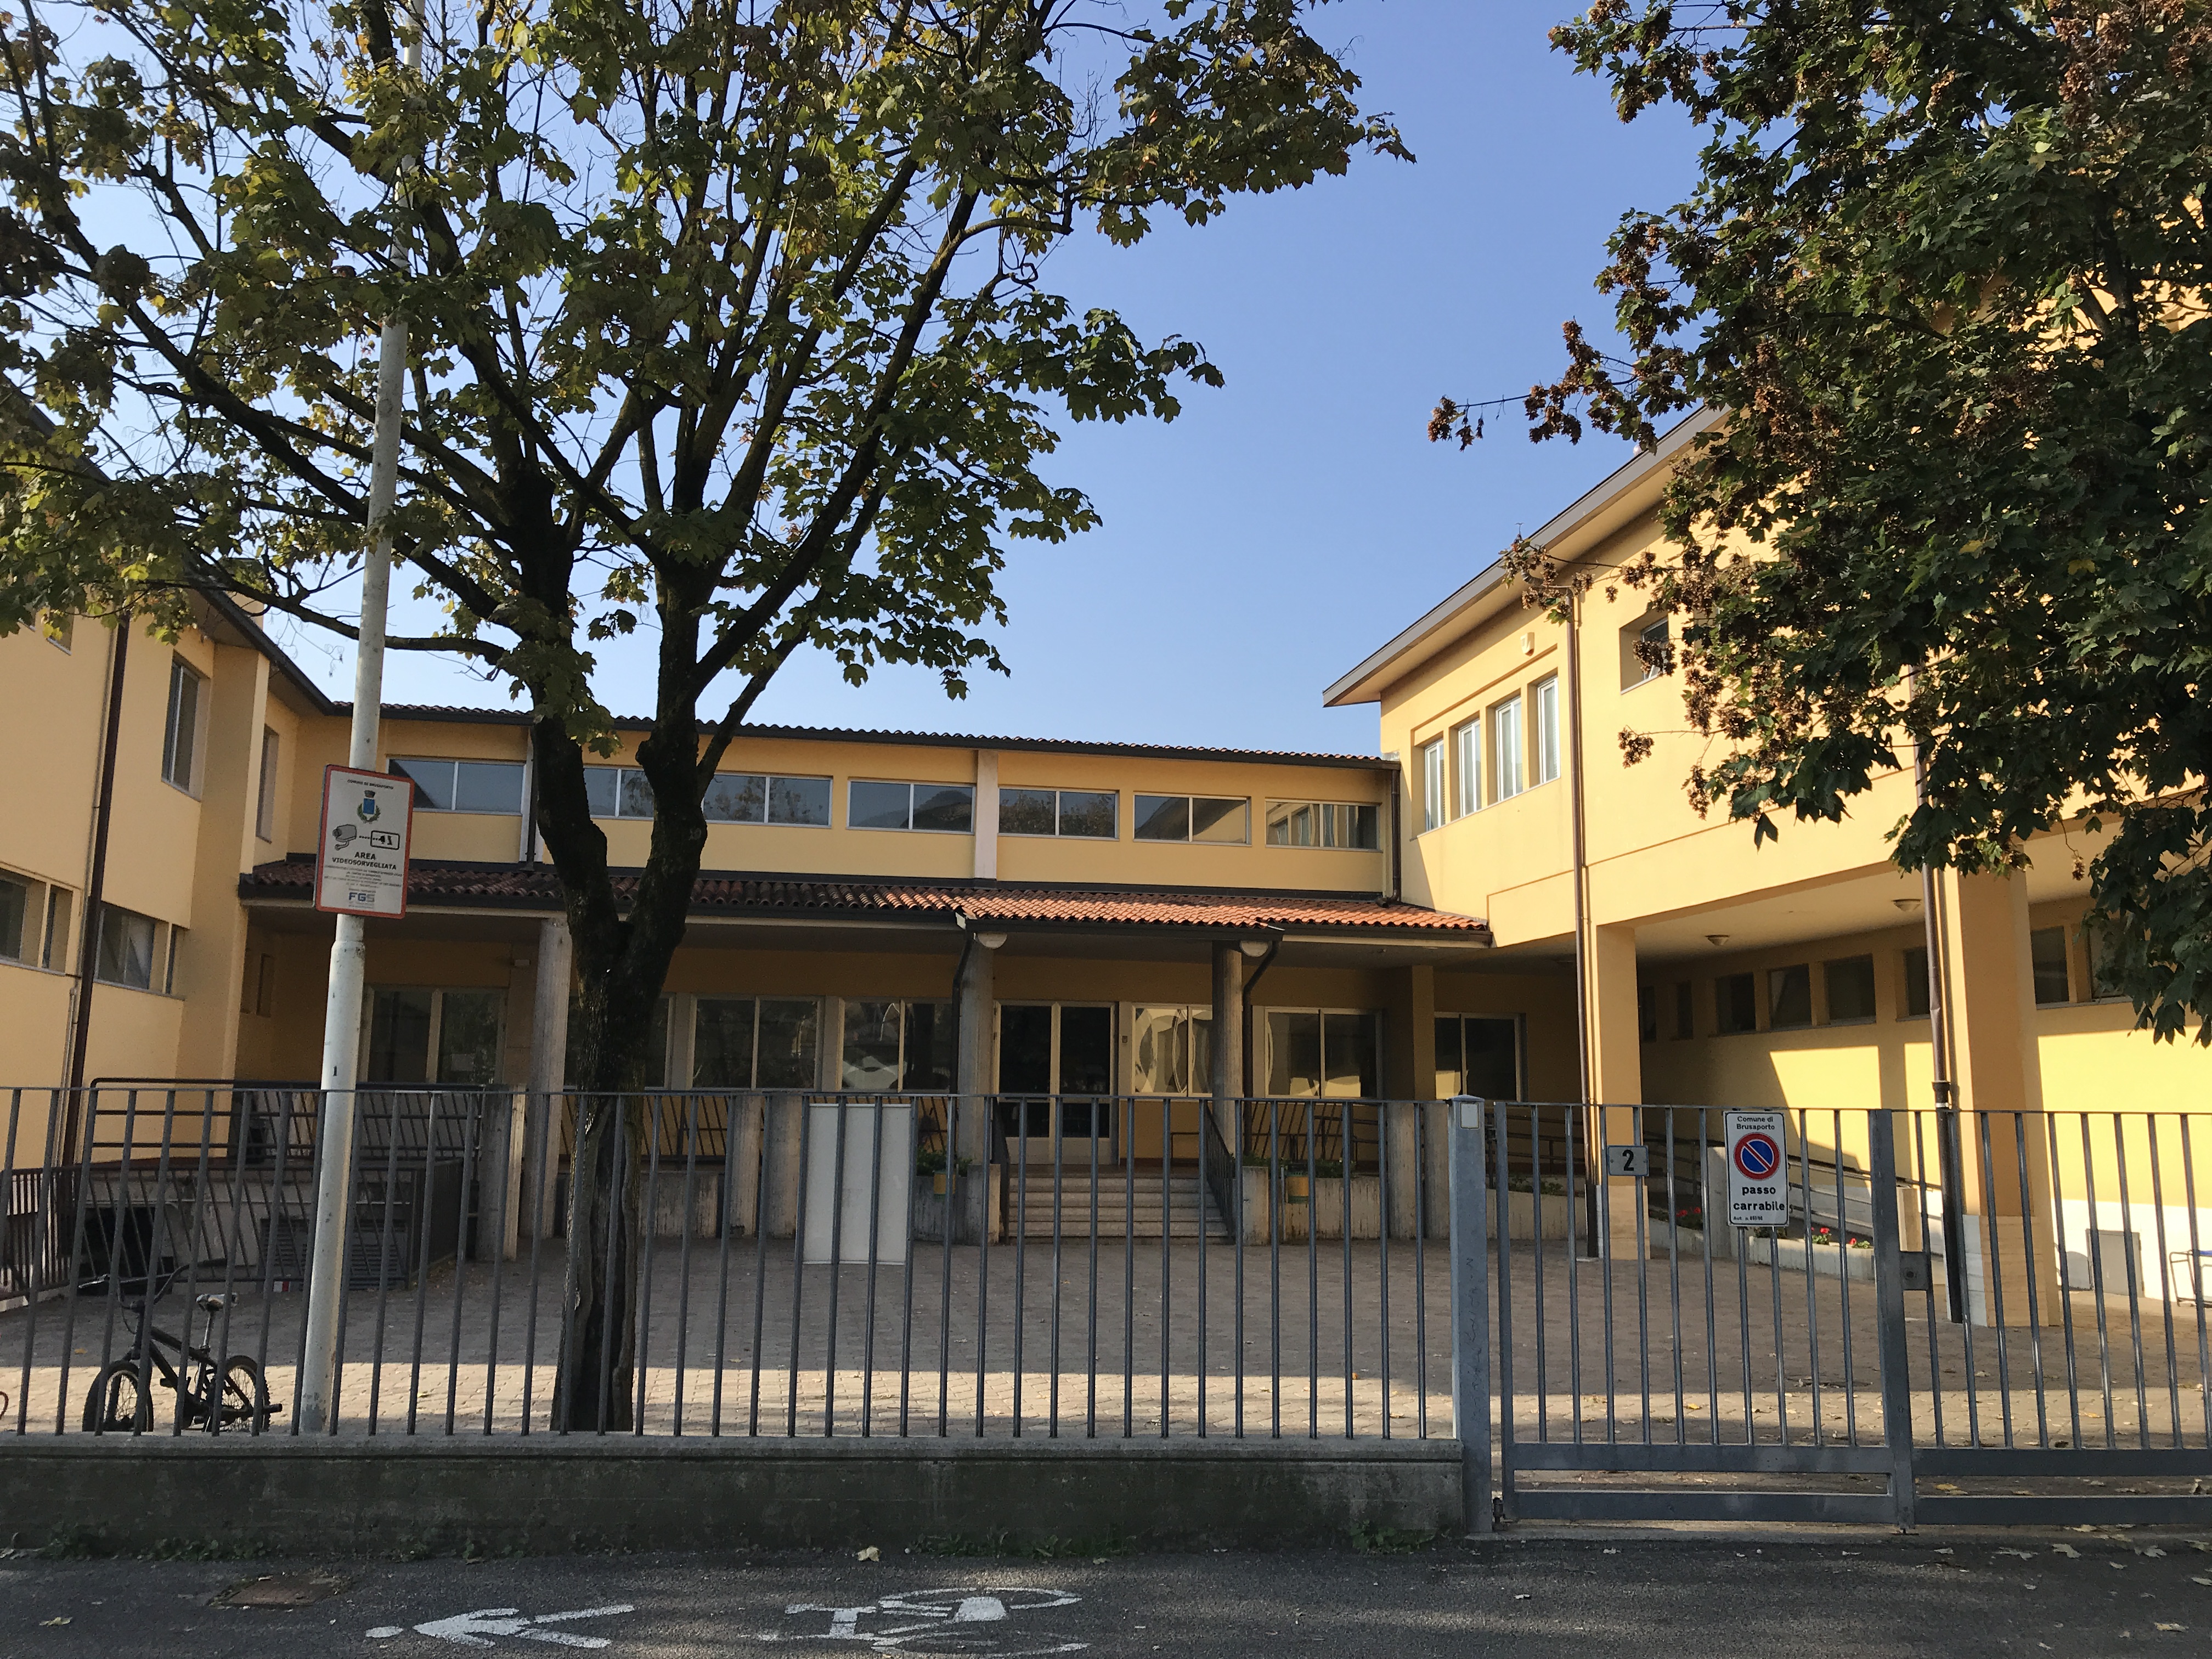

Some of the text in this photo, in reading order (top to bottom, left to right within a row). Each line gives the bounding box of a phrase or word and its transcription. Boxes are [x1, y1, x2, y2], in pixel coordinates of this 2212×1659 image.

[354, 851, 376, 860] AREA
[332, 857, 397, 870] VIDEOSORVEGLIATA
[349, 892, 375, 902] FGS
[1622, 1149, 1634, 1171] 2
[1742, 1187, 1776, 1196] passo
[1733, 1201, 1785, 1211] carrabile
